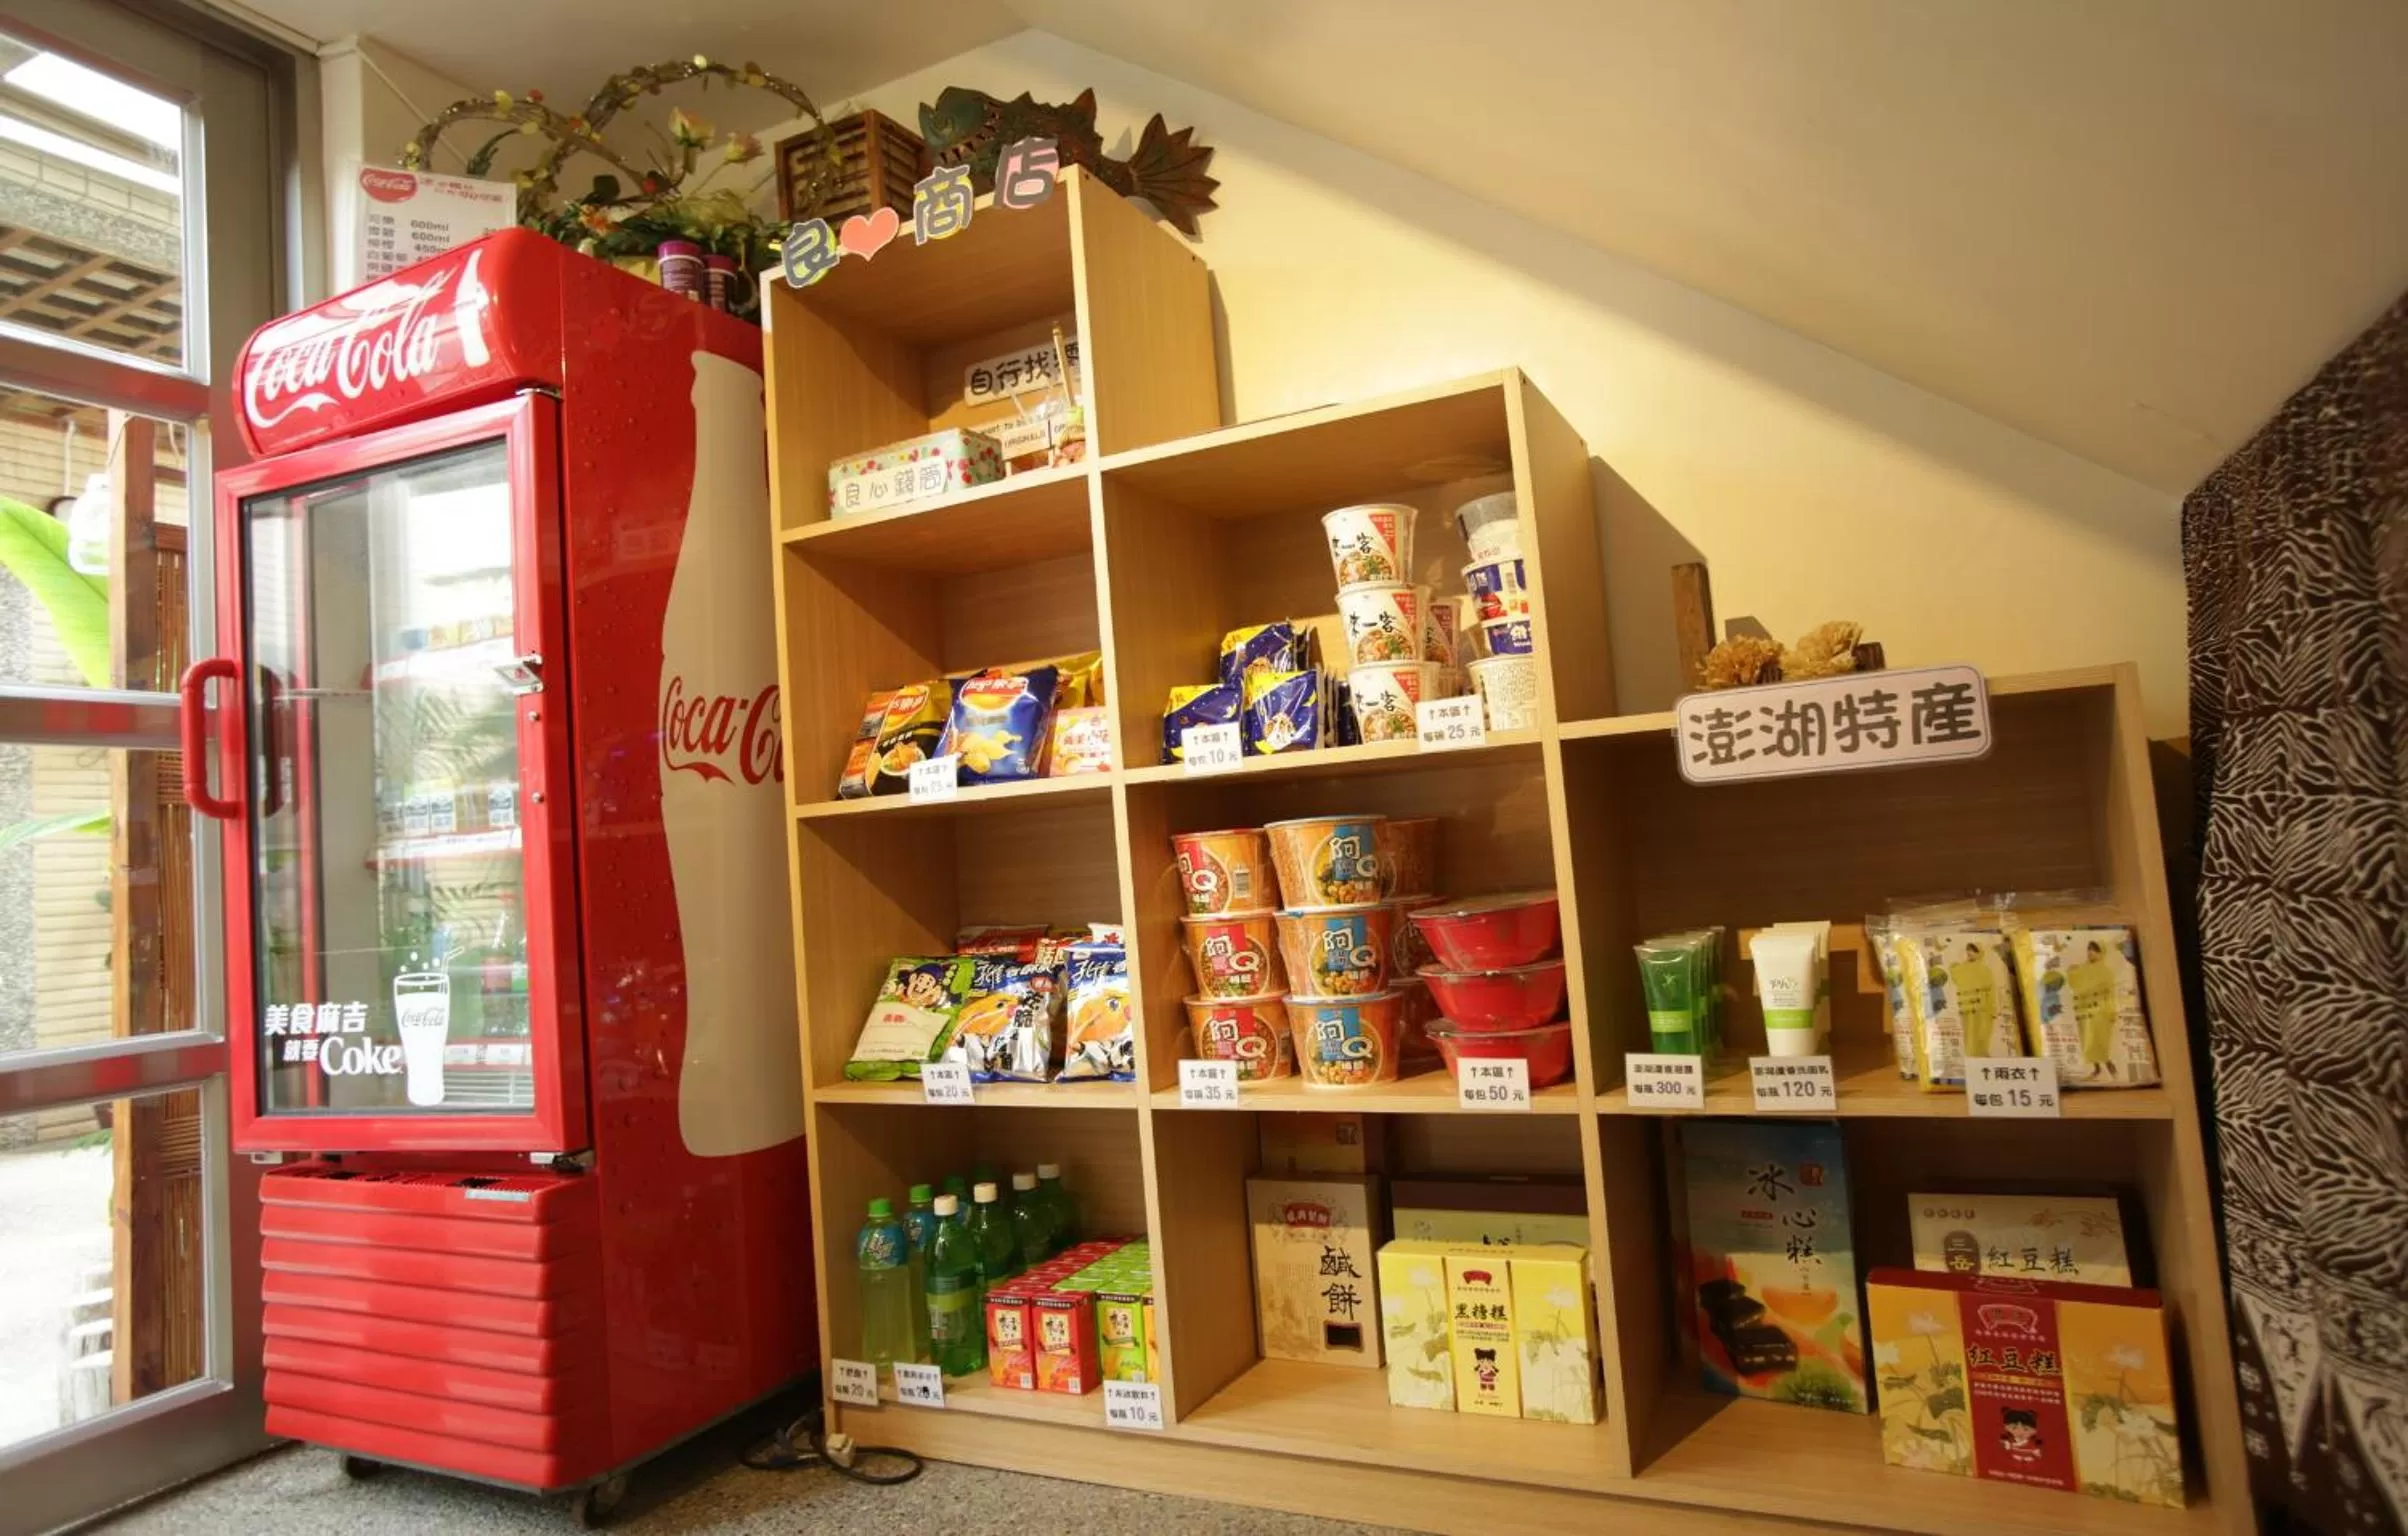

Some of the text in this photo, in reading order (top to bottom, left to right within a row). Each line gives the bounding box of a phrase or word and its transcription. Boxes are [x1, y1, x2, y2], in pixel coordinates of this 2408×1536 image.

[1689, 682, 1981, 766] 澎湖特產
[264, 1001, 369, 1036] 美食麻吉
[320, 1036, 404, 1076] Coke
[1747, 1163, 1823, 1265] 冰心糕
[1987, 1246, 2080, 1276] 紅豆糕
[1319, 1245, 1363, 1321] 鹹餅
[1454, 1303, 1509, 1322] 黑糖糕
[1967, 1342, 2062, 1376] 紅豆糕
